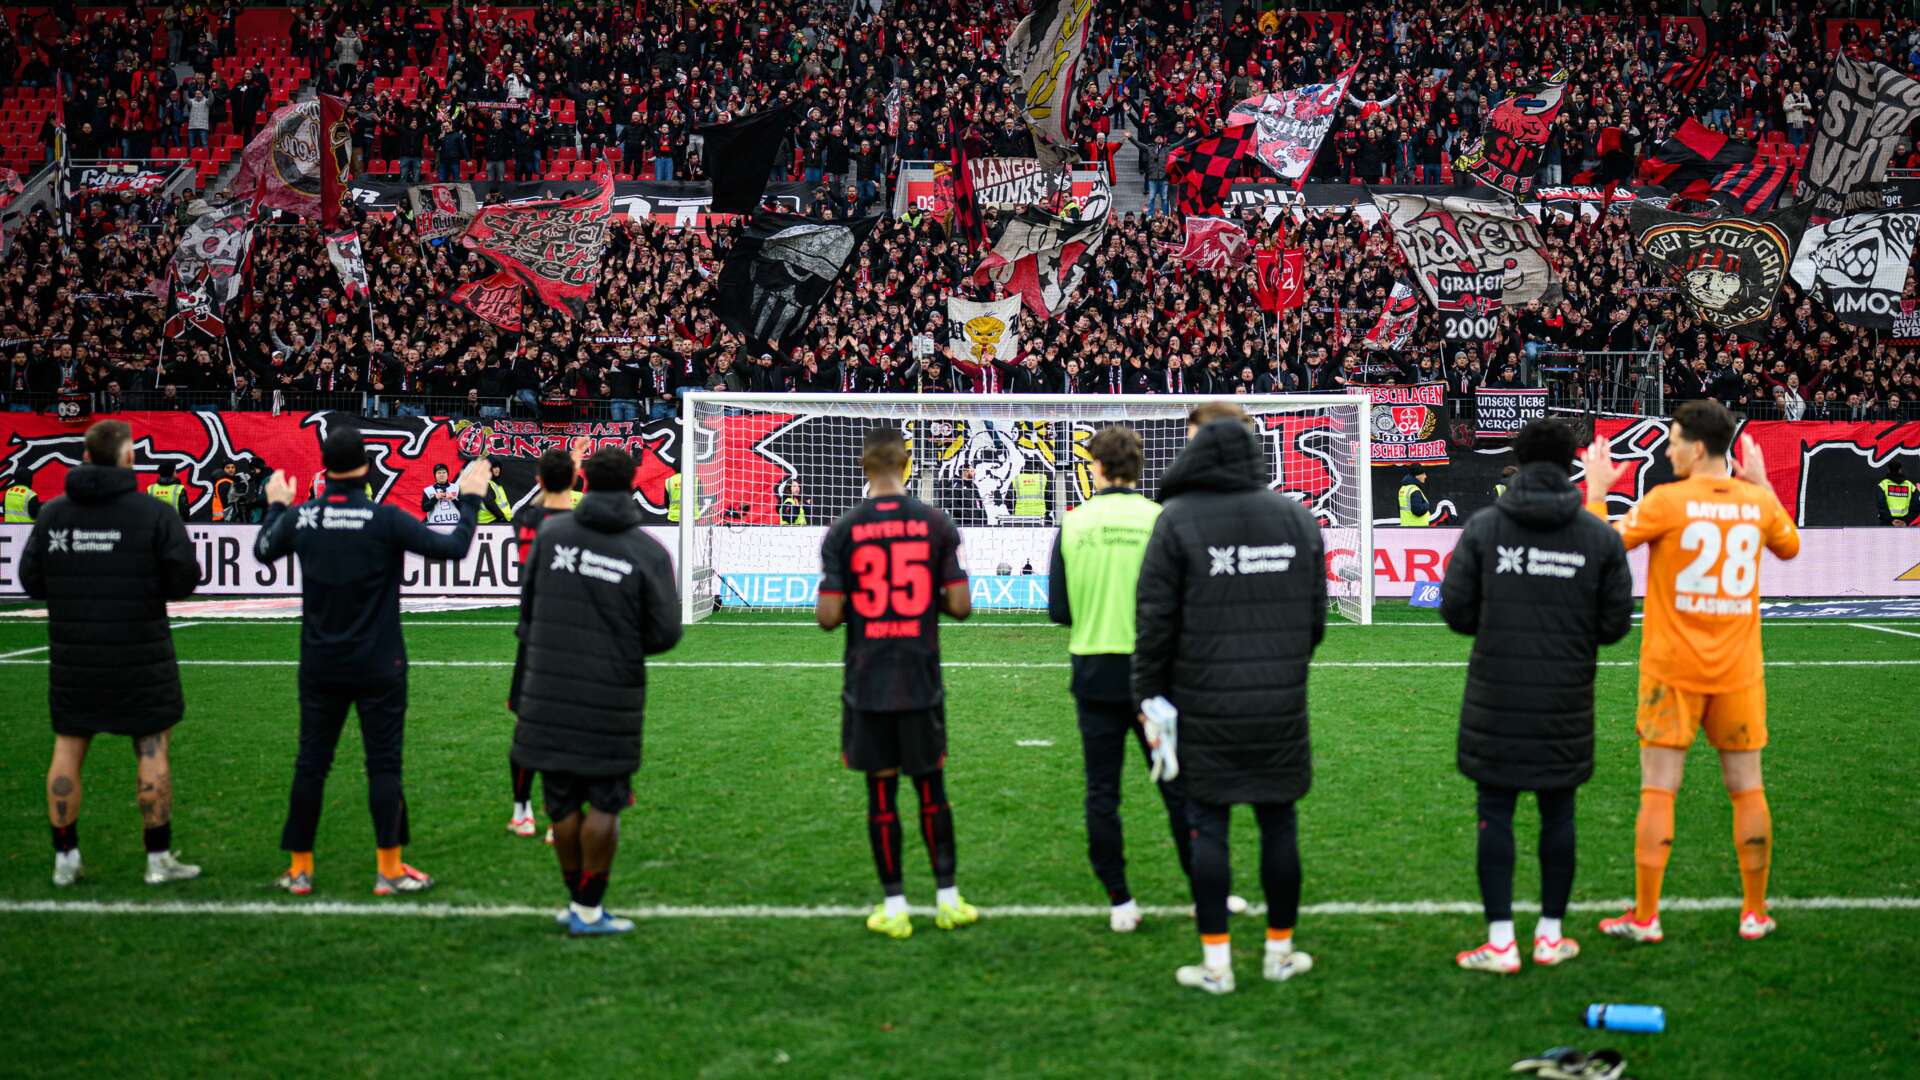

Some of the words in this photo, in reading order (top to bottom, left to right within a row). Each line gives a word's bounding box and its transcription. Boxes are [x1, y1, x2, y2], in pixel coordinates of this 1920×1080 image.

[1445, 316, 1498, 339] 2009
[1477, 418, 1528, 430] VERGEH
[1384, 434, 1415, 442] 2024
[1408, 440, 1447, 457] MEISTER
[323, 507, 373, 520] Barmenia
[433, 513, 459, 523] CLUB
[1686, 501, 1739, 519] BAYER
[1740, 502, 1761, 520] 04
[852, 521, 905, 542] BAYER
[193, 532, 240, 587] ÜR
[1238, 544, 1296, 561] Barmenia
[1527, 547, 1586, 567] Barmenia
[1675, 522, 1761, 596] 28
[851, 542, 933, 619] 35
